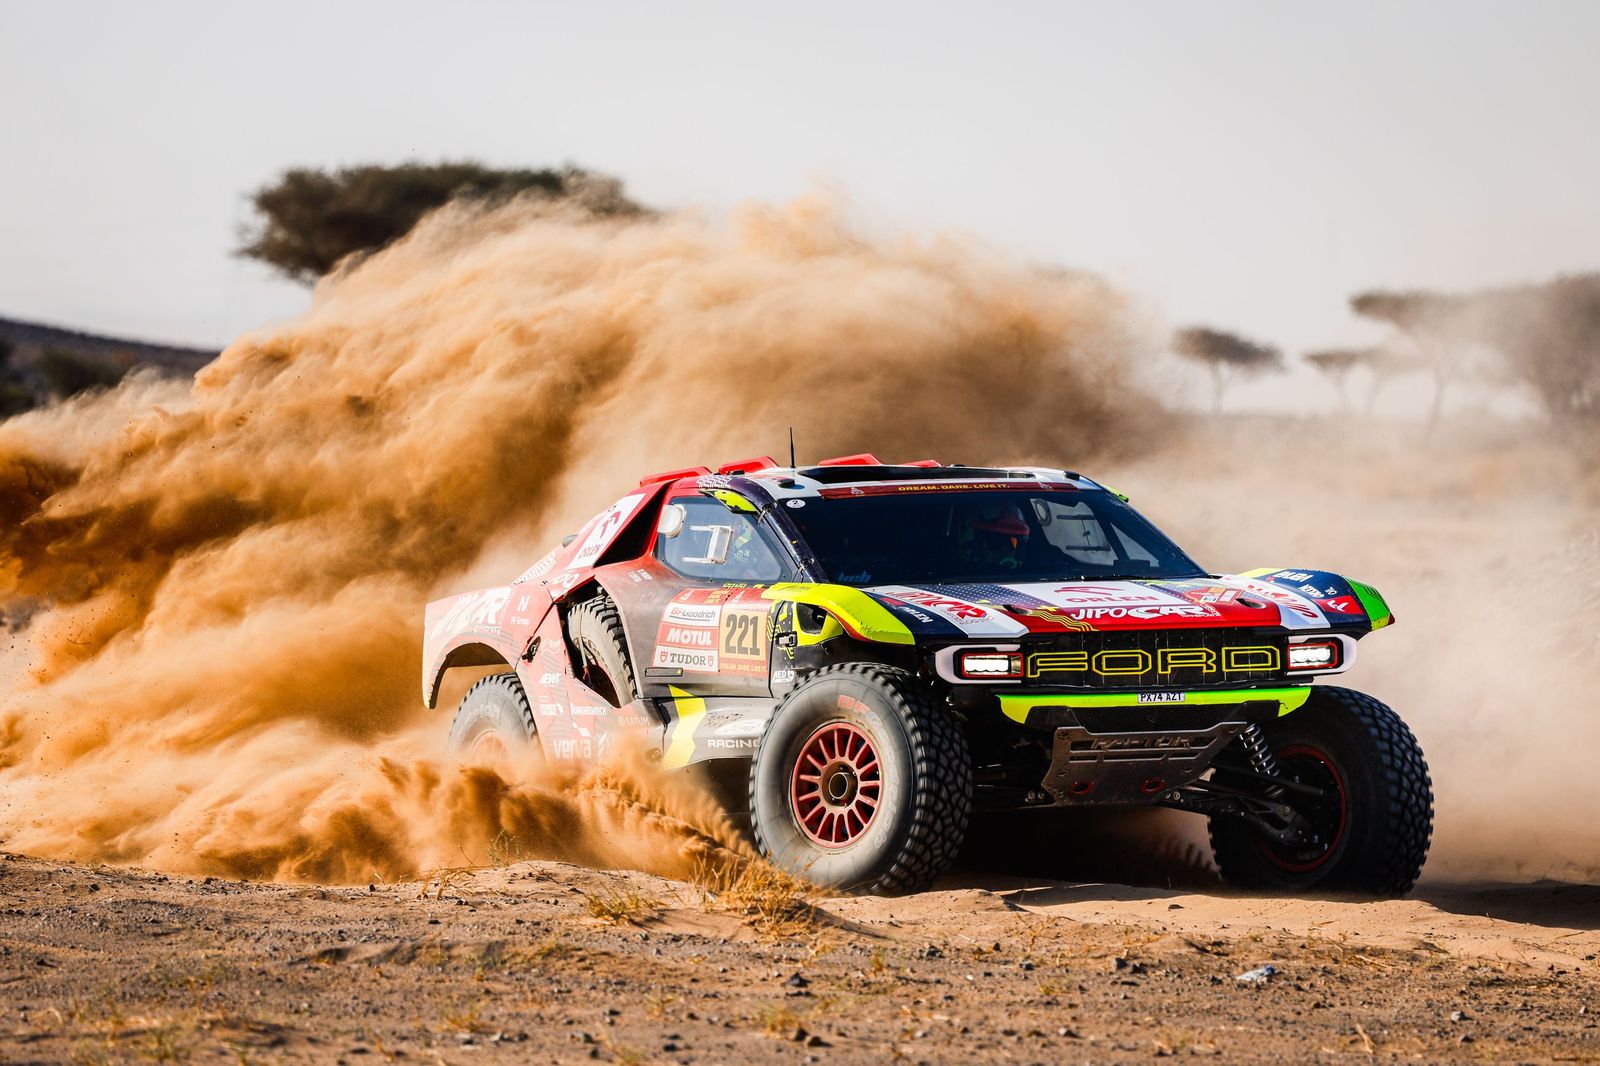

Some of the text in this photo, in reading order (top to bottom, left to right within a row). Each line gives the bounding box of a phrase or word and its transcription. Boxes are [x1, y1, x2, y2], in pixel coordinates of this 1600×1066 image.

[670, 607, 716, 619] BFGoodrich
[1071, 606, 1206, 620] JIPOCAR
[666, 628, 712, 646] MOTUL
[725, 613, 761, 656] 221
[670, 653, 706, 666] TUDOR
[1028, 646, 1281, 678] FORD
[1140, 692, 1182, 702] PX74 AZT
